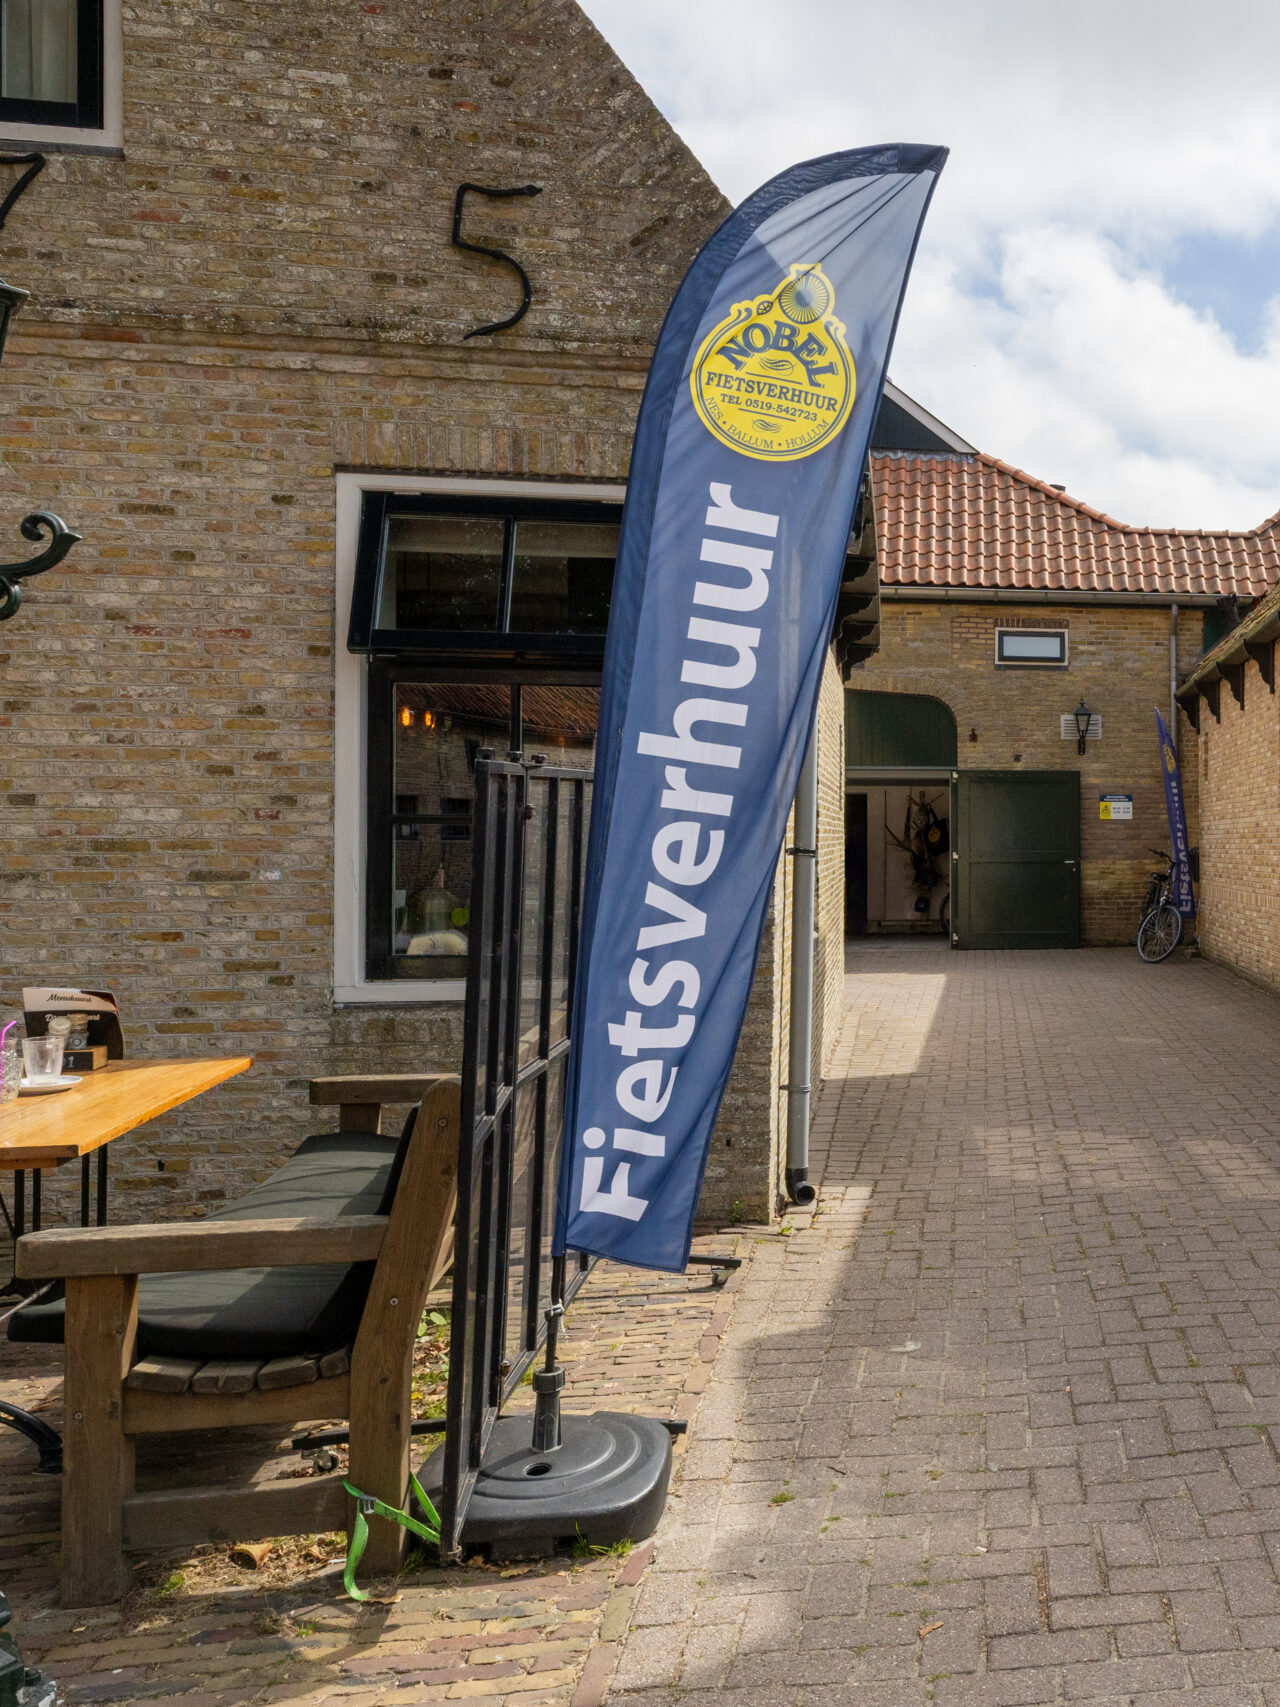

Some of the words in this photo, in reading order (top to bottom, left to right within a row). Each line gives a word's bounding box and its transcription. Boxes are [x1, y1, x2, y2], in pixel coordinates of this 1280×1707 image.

[452, 183, 543, 341] 5
[715, 320, 840, 389] NOBEL
[705, 371, 839, 412] FIETSVERHUUR
[720, 393, 742, 406] TEL
[745, 398, 818, 422] 0519-542723
[705, 396, 724, 421] NES
[727, 424, 774, 449] BALLUM
[785, 419, 830, 449] HOLLUM
[579, 481, 781, 1222] Fietsverhuur
